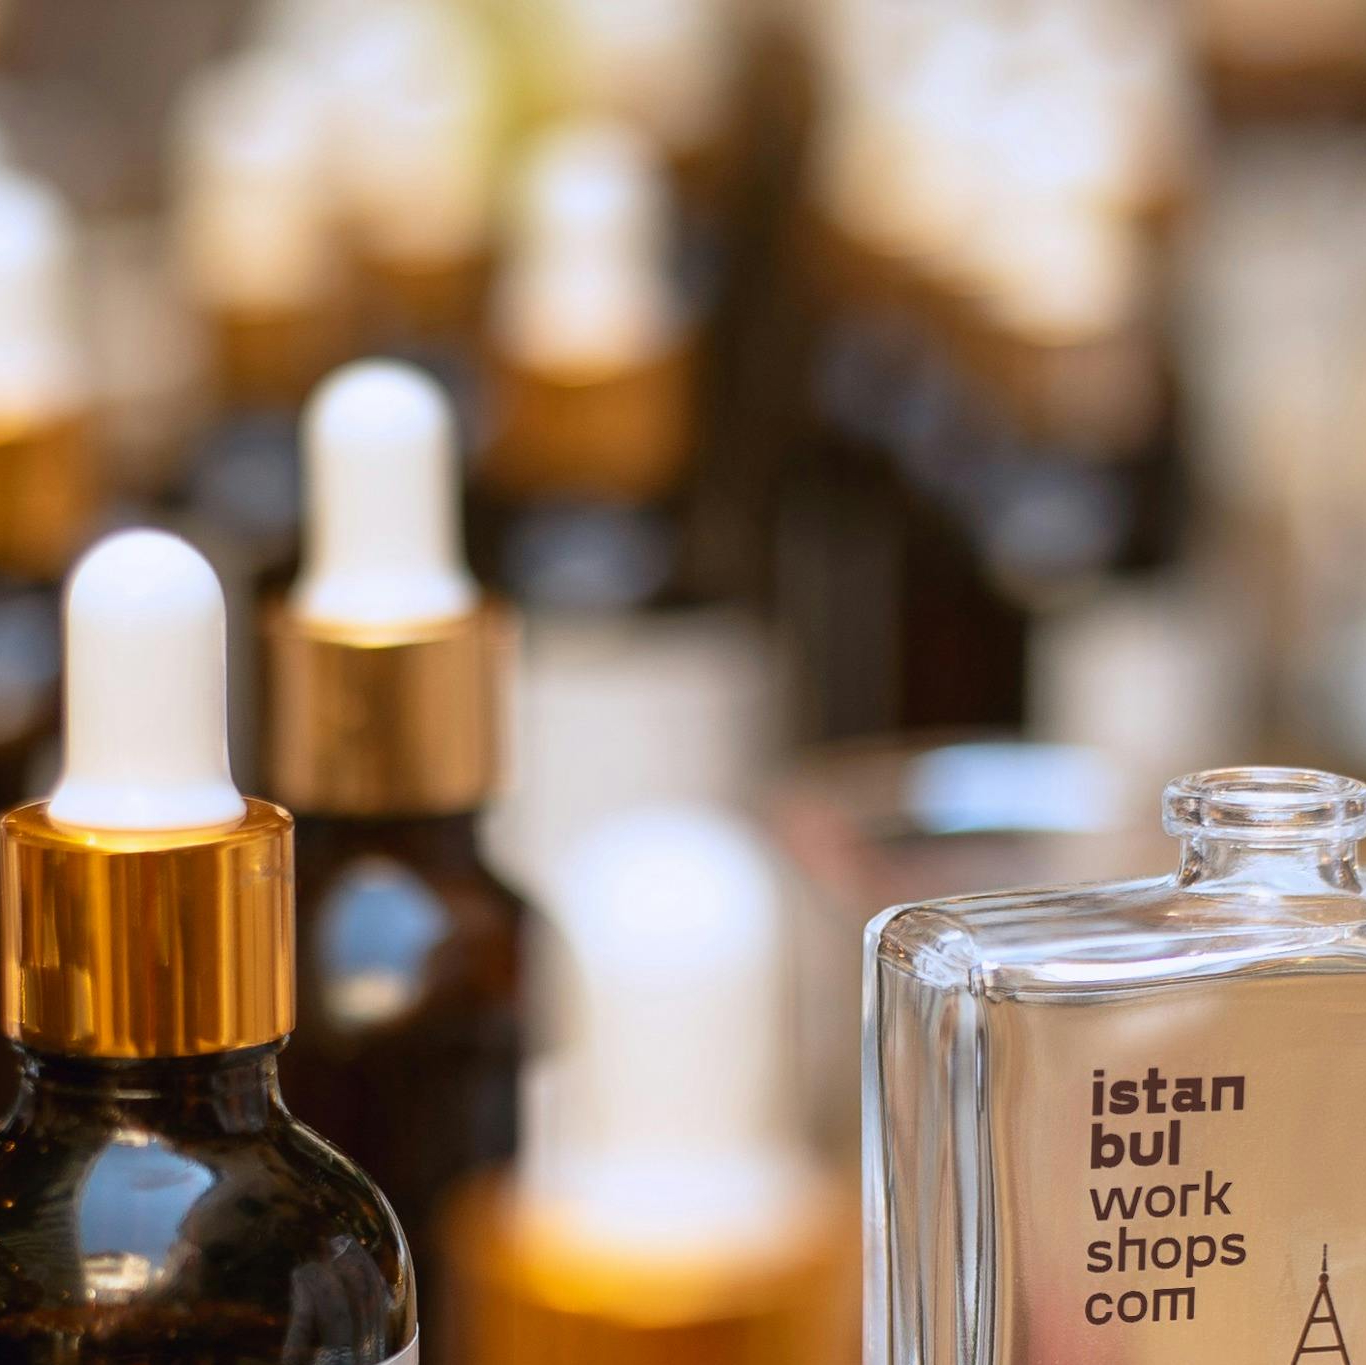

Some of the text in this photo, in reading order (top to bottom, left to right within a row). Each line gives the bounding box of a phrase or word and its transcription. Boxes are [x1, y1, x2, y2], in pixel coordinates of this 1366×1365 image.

[1091, 1067, 1245, 1116] istan
[1090, 1119, 1181, 1169] bul
[1089, 1170, 1233, 1221] work
[1086, 1226, 1247, 1278] shops
[1085, 1286, 1196, 1325] com
